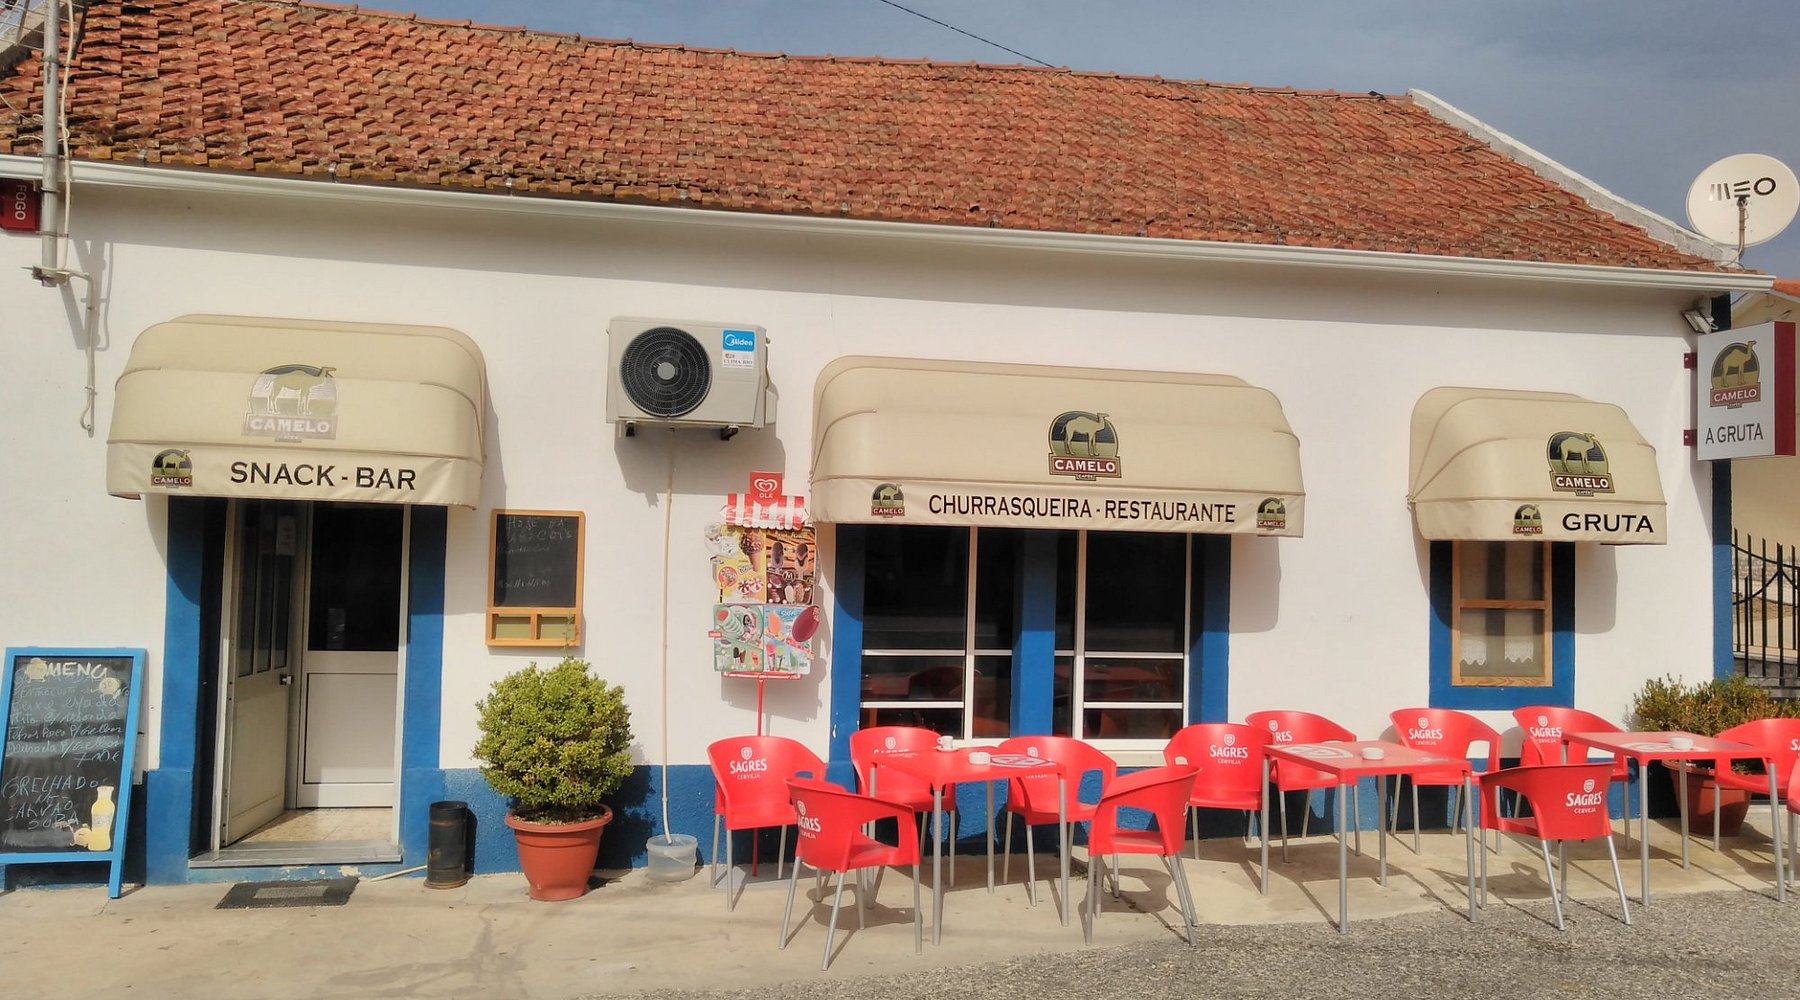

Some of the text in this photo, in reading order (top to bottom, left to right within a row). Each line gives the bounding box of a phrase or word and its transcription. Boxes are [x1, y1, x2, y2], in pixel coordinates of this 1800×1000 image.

[15, 184, 27, 220] FOGO
[725, 334, 753, 347] Midea
[1713, 388, 1758, 402] CAMELO
[249, 418, 330, 433] CAMELO
[1705, 423, 1764, 444] A GRUTA
[1054, 459, 1116, 472] CAMELO
[153, 476, 191, 484] CAMELO
[230, 461, 335, 487] SNACK
[355, 466, 417, 490] BAR
[1555, 476, 1609, 488] CAMELO
[873, 507, 904, 515] CAMELO
[928, 494, 1092, 518] CHURRASQUEIRA
[1105, 500, 1236, 523] RESTAURANTE
[1258, 520, 1285, 528] CAMELO
[1562, 513, 1654, 533] GRUTA
[1273, 731, 1293, 742] RES
[1408, 728, 1443, 740] SAGRES
[1529, 726, 1562, 738] SAGRES
[1209, 745, 1248, 759] SAGRES
[729, 758, 768, 775] SAGRES
[2, 774, 108, 799] GRELHADO
[1565, 791, 1603, 807] SAGRES
